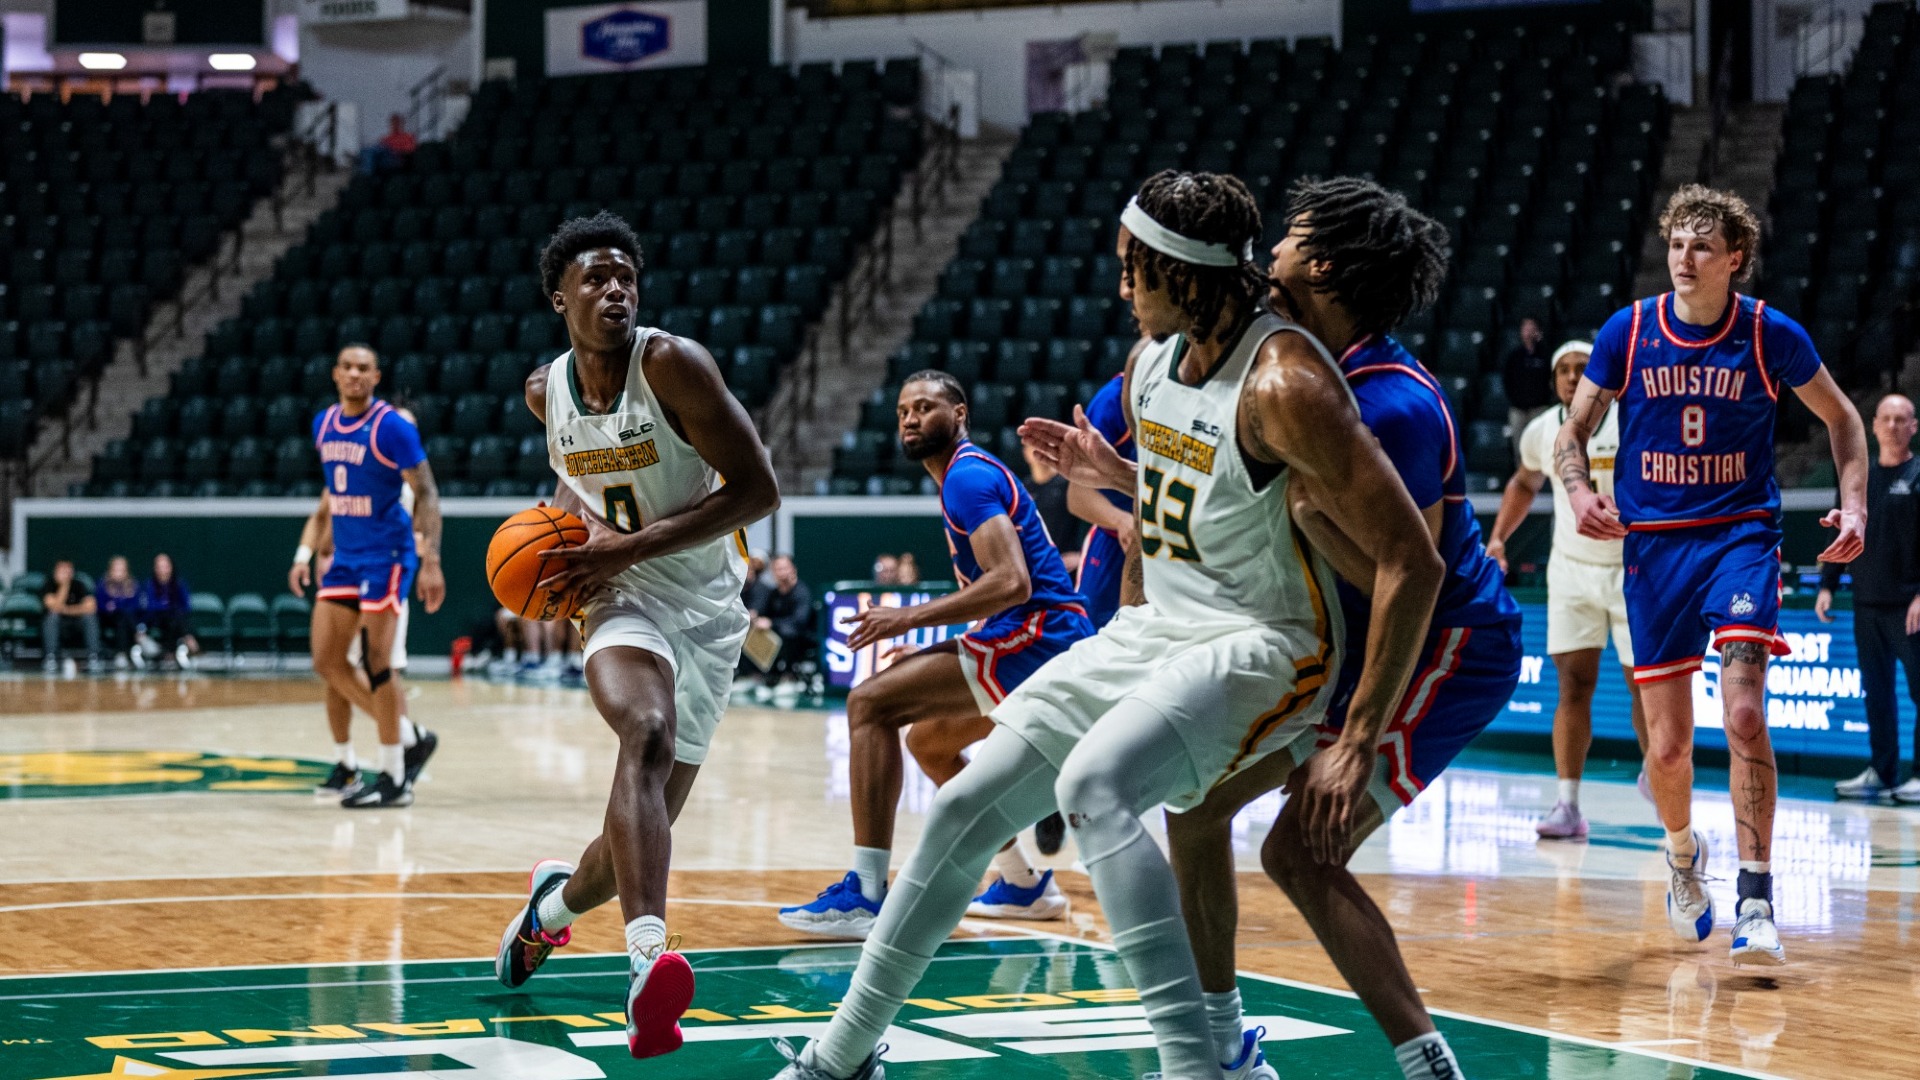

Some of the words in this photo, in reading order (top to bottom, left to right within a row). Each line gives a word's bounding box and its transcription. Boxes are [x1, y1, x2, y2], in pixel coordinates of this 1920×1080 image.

[1641, 364, 1746, 401] HOUSTON
[618, 422, 654, 442] SLC
[1682, 404, 1706, 448] 8
[334, 464, 348, 493] 0
[1641, 450, 1746, 485] CHRISTIAN
[602, 482, 643, 534] 0
[1141, 465, 1203, 563] 23
[1766, 665, 1862, 698] GUARAN
